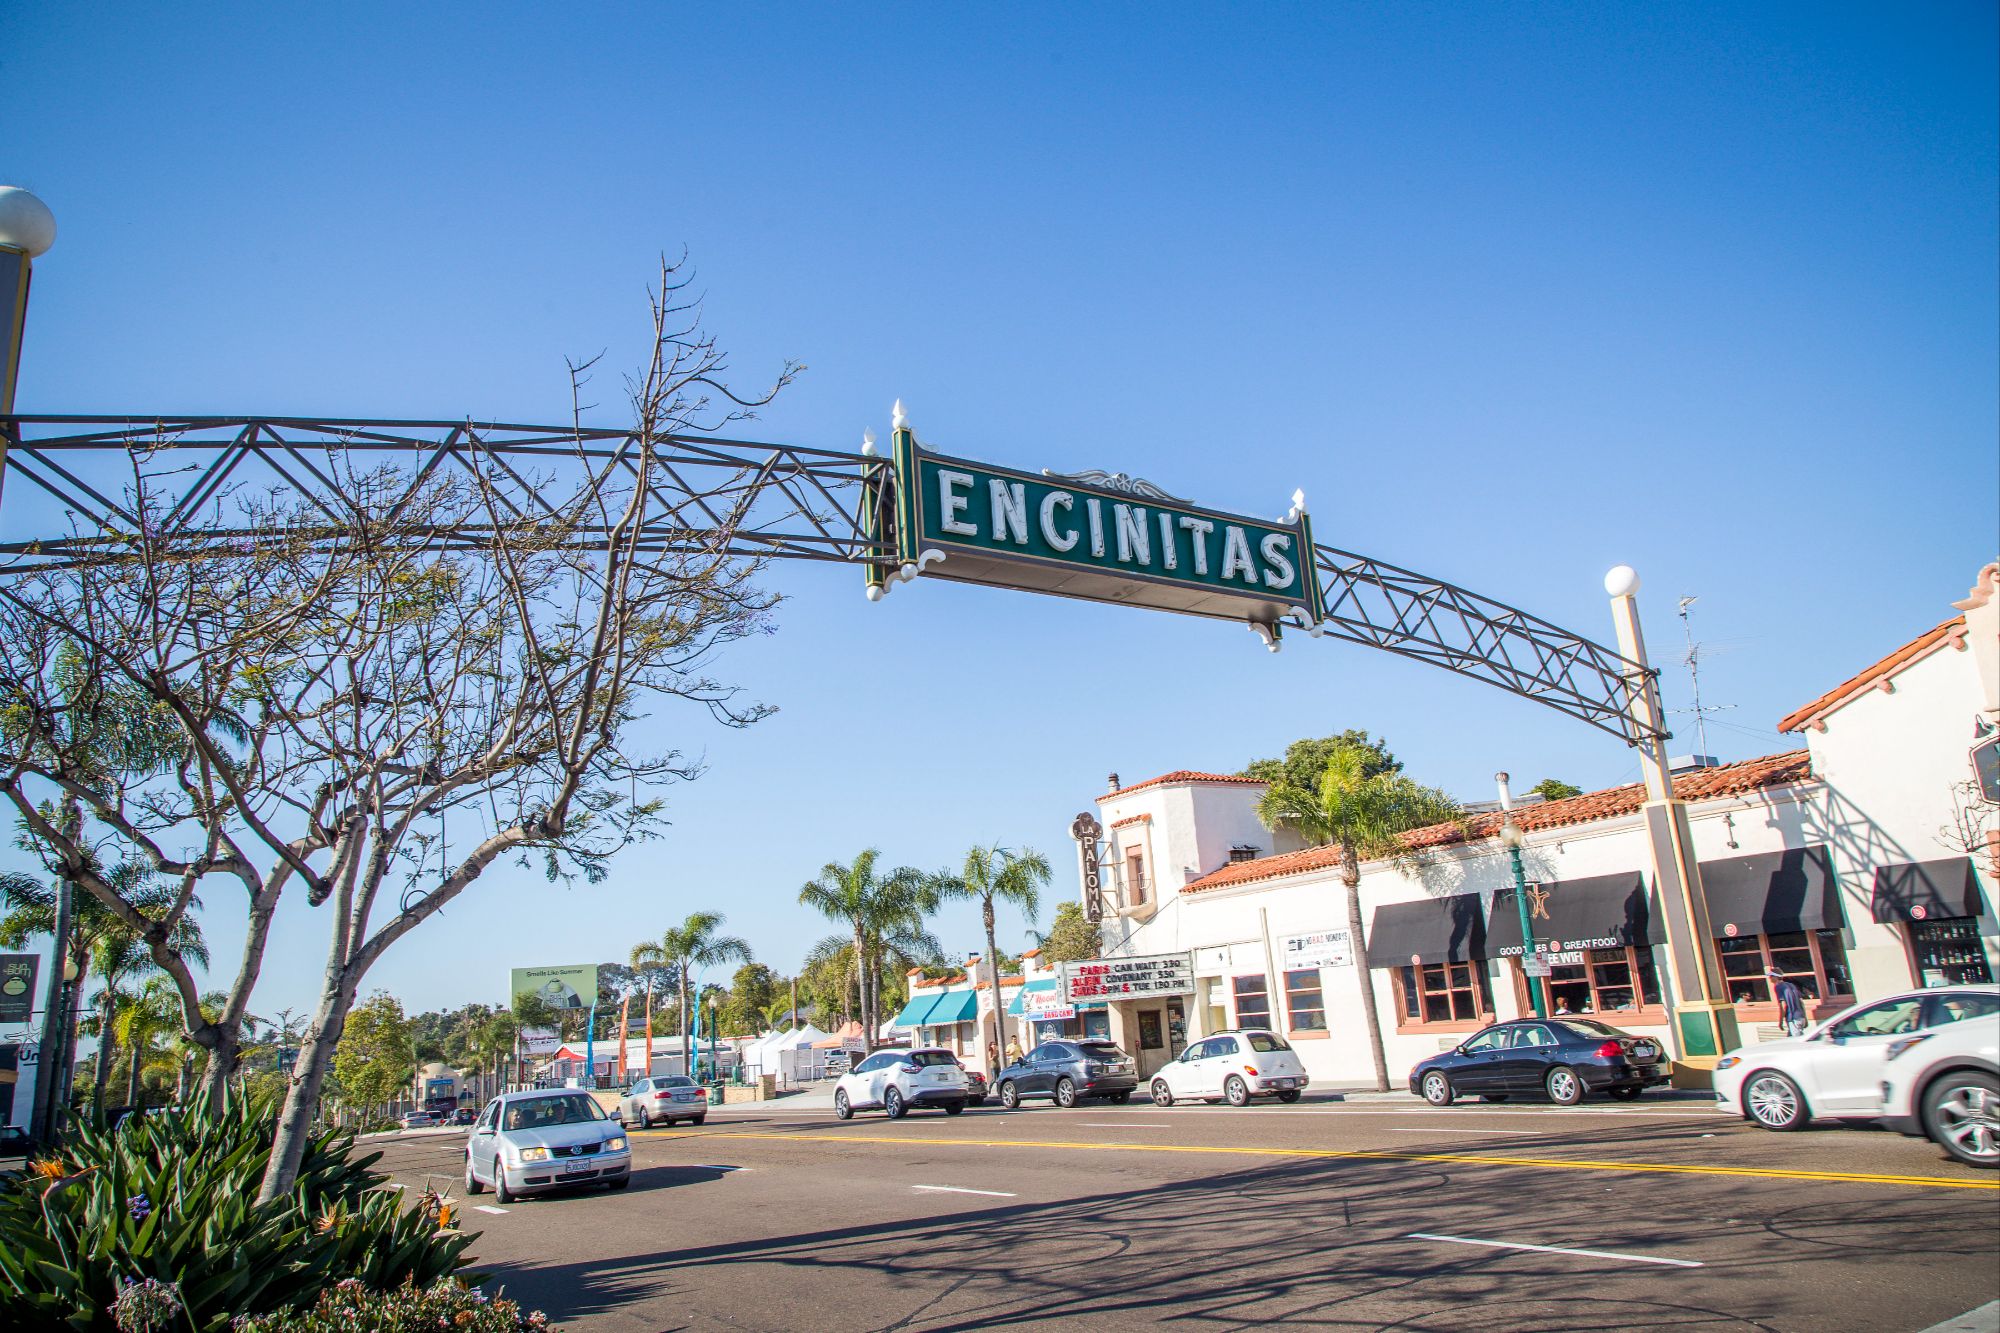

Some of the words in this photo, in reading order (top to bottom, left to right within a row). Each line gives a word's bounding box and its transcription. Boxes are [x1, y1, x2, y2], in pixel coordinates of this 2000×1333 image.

[937, 468, 1295, 589] ENCINITAS
[1081, 826, 1094, 834] LA
[1084, 837, 1100, 914] PALOMA
[1500, 946, 1522, 955] GOOD
[1522, 944, 1548, 953] TES
[1563, 940, 1591, 950] GREAT
[1592, 937, 1618, 947] FOOD
[1547, 952, 1559, 964] EE
[1079, 965, 1111, 976] PARIS
[1114, 963, 1133, 973] CAN
[1135, 961, 1157, 970] WAIT
[1071, 975, 1102, 987] ALIEN
[1105, 972, 1153, 983] COVENANT
[1133, 982, 1150, 991] TUE
[1173, 979, 1185, 988] PM
